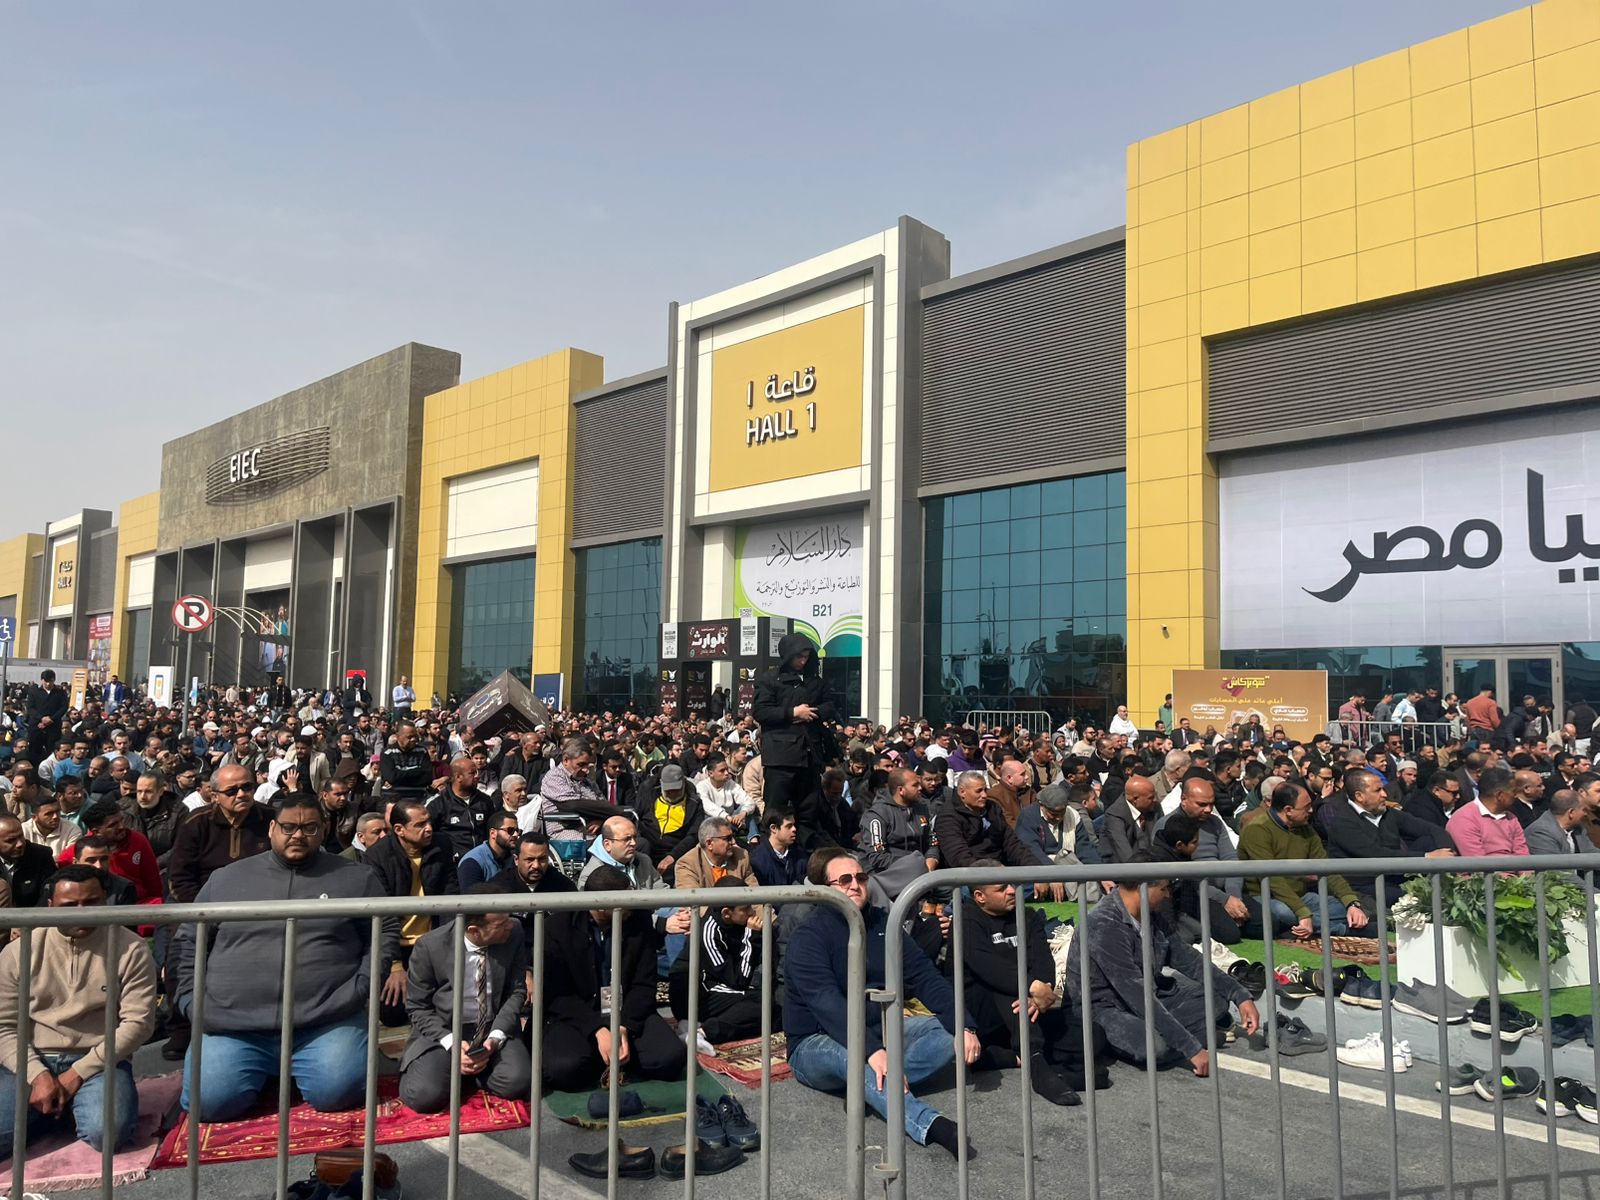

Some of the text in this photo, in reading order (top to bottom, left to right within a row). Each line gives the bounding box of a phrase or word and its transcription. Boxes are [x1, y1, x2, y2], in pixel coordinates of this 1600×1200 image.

[765, 366, 817, 402] قاعة
[746, 401, 817, 447] HALL 1
[230, 448, 261, 483] EIEC
[1301, 518, 1503, 603] مصر
[812, 603, 833, 617] B21
